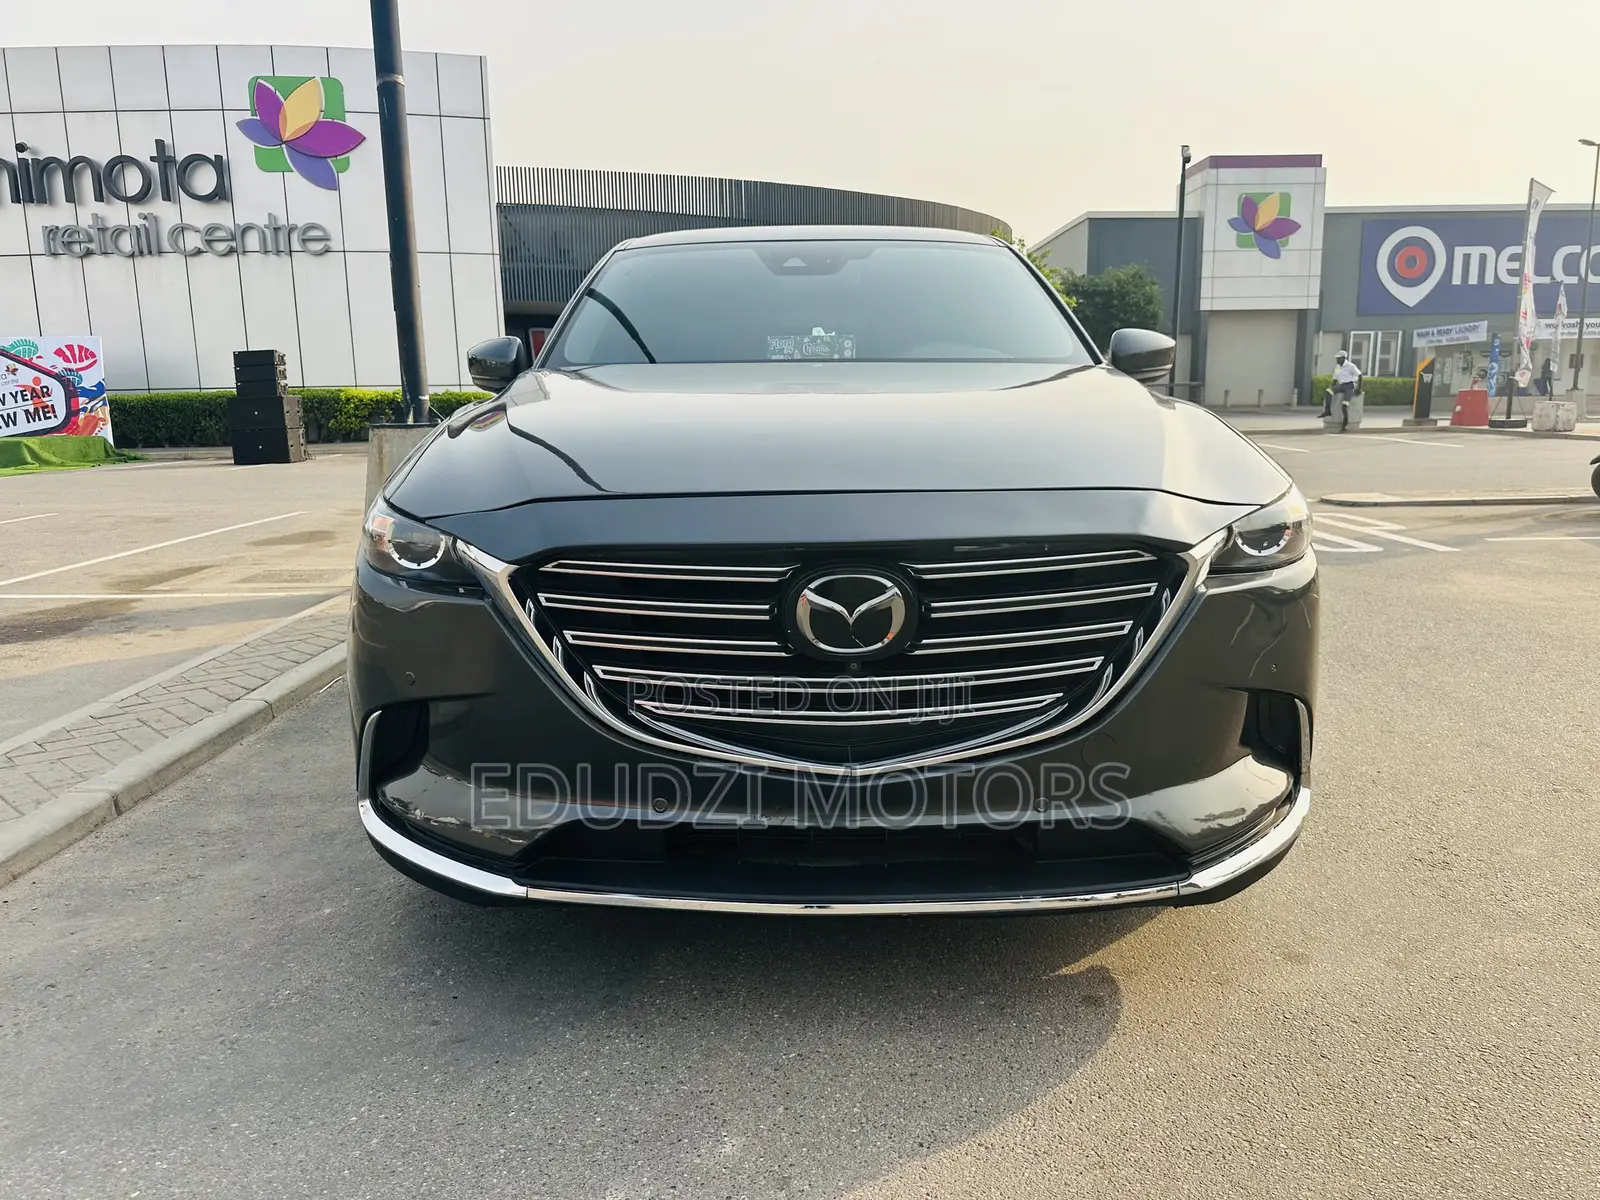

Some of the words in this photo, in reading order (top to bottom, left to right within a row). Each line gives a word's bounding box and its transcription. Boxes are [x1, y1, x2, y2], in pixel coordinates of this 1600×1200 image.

[41, 213, 160, 257] retail
[167, 213, 331, 257] centre
[1454, 324, 1480, 334] LAUNDRY
[9, 385, 53, 404] YEAR
[24, 404, 58, 424] ME!
